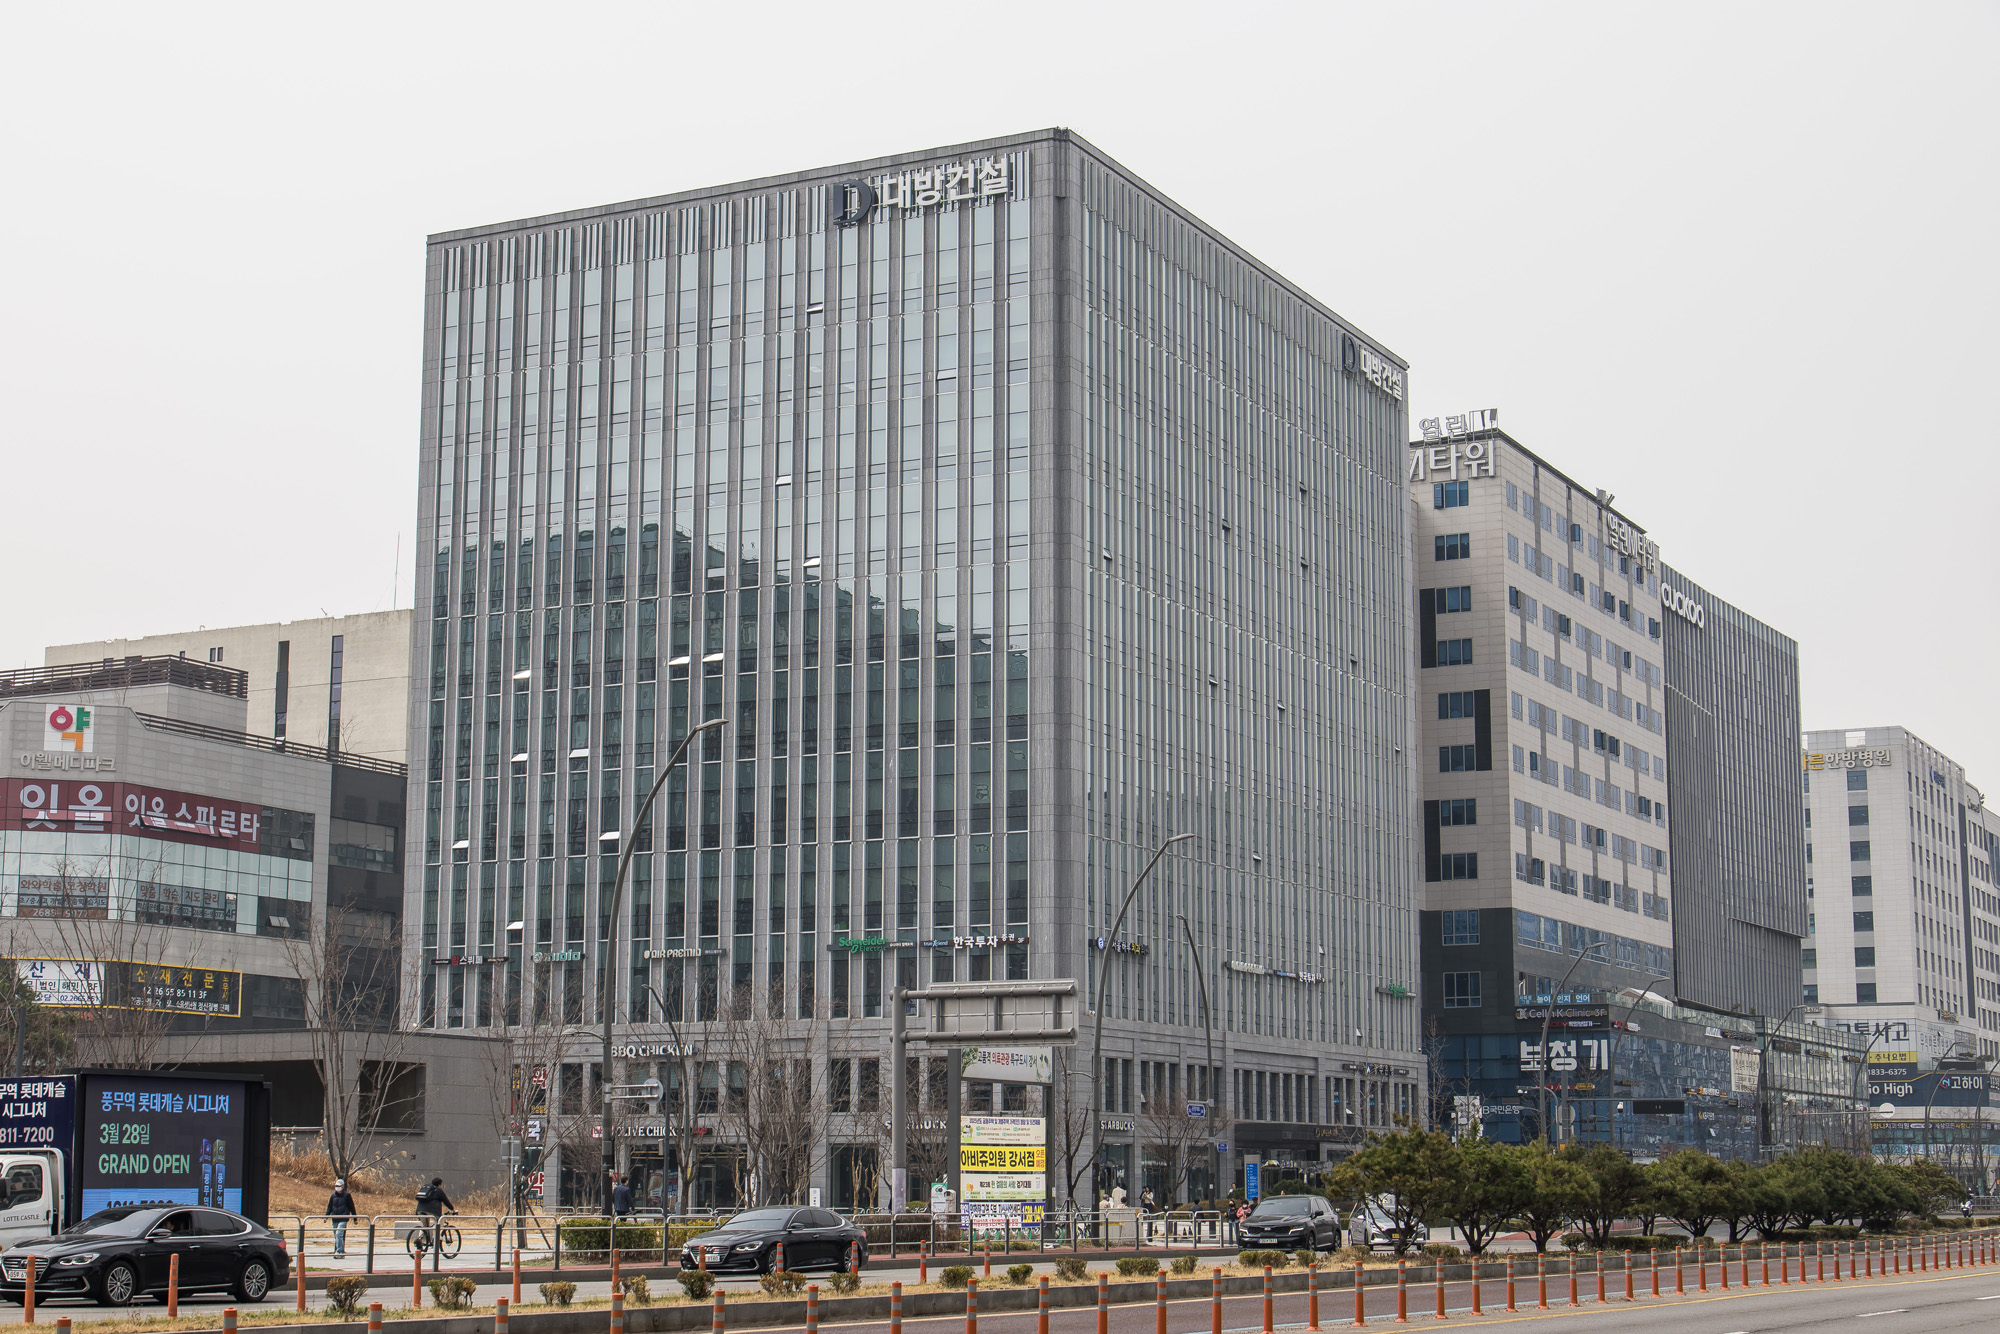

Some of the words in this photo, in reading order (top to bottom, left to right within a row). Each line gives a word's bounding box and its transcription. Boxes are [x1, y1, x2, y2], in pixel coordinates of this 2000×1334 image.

[883, 157, 1009, 209] 대방건설
[1360, 349, 1402, 401] 대방건설
[1419, 414, 1468, 441] 열린
[1661, 582, 1704, 628] CUCKOO
[49, 706, 91, 750] 약
[20, 753, 116, 772] 이웰메디파크
[175, 802, 260, 842] 스파르타
[140, 885, 156, 899] 맞춤
[163, 888, 179, 901] 학습
[185, 891, 200, 903] 지도
[204, 893, 219, 905] 관리
[226, 909, 236, 919] 4F
[839, 936, 888, 947] Schneider
[953, 935, 998, 949] 한국투자
[1002, 933, 1015, 942] 증권
[1536, 994, 1551, 1004] 놀이
[1556, 994, 1571, 1004] 인지
[1575, 993, 1590, 1003] 언어
[1529, 1009, 1555, 1018] Celln
[1556, 1009, 1564, 1017] K
[1565, 1008, 1591, 1018] Clinic
[1595, 1008, 1605, 1017] 3F
[612, 1046, 636, 1059] BBQ
[992, 1052, 1010, 1066] 의료관광
[1010, 1053, 1028, 1067] 특구도시
[1029, 1055, 1038, 1068] 강서
[1520, 1040, 1608, 1071] 보청기
[1875, 1053, 1907, 1061] 추나요법
[20, 1081, 67, 1099] 롯데캐슬
[1884, 1082, 1913, 1097] High
[1951, 1076, 1983, 1090] 고하이
[2, 1101, 47, 1118] 시그니처
[101, 1091, 135, 1112] 풍무역
[138, 1092, 184, 1113] 롯데캐슬
[186, 1093, 229, 1114] 시그니처
[100, 1123, 119, 1144] 3월
[122, 1123, 150, 1144] 28일
[1101, 1120, 1135, 1131] STARBUCKS
[98, 1153, 150, 1174] GRAND
[153, 1154, 190, 1174] OPEN
[961, 1150, 1006, 1167] 아비쥬의원
[1009, 1151, 1035, 1167] 강서점
